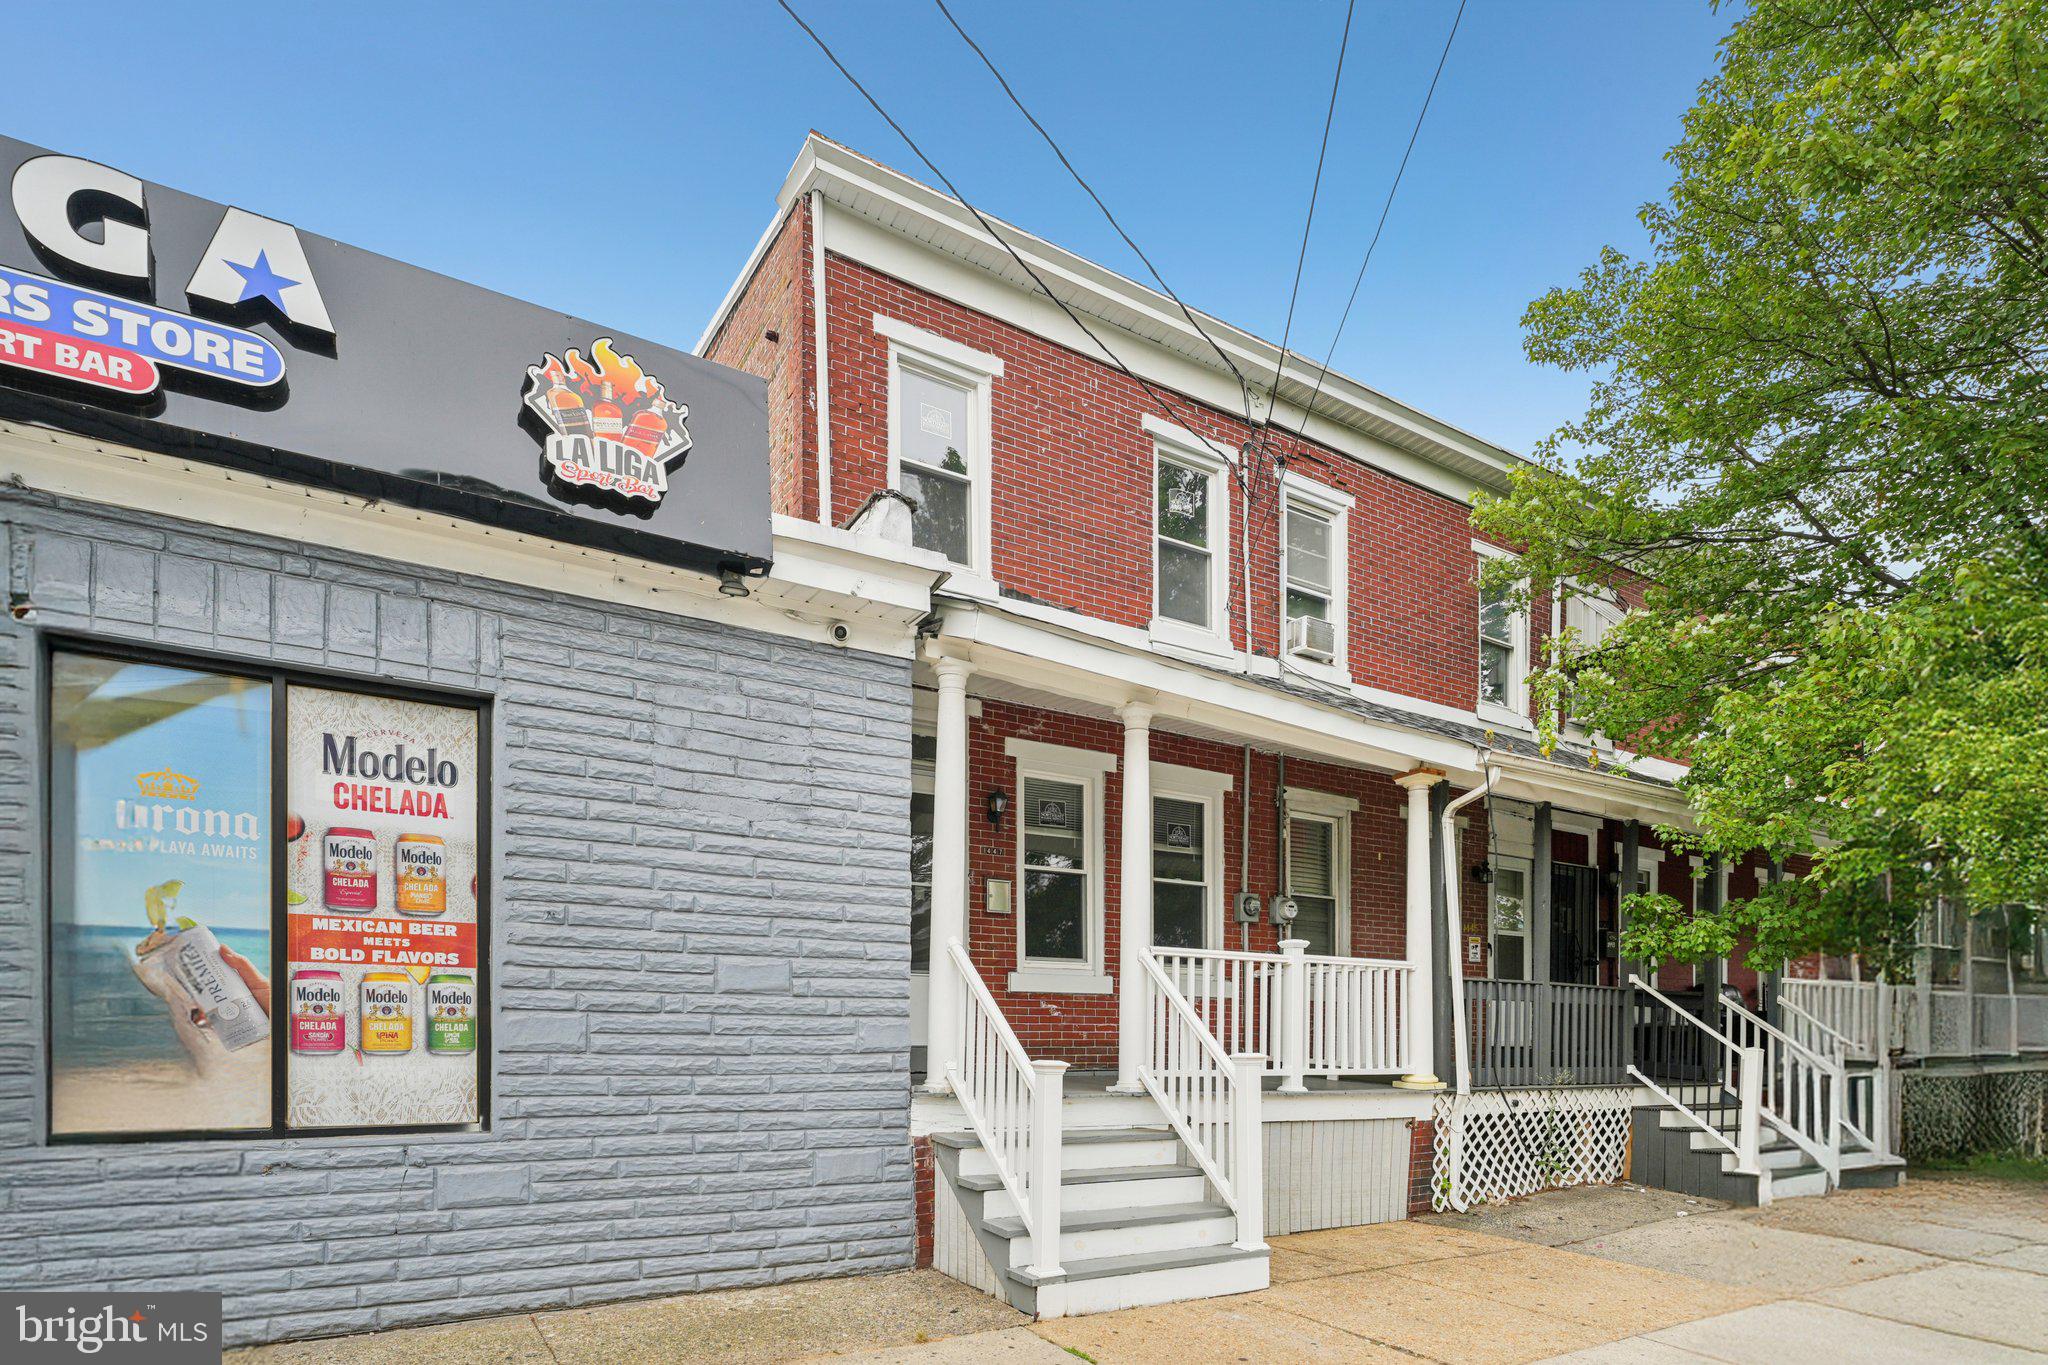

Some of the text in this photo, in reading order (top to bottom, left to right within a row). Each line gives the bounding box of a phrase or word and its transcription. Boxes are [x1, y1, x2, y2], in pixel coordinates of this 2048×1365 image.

[73, 300, 264, 377] STORE
[0, 328, 132, 382] RT BAR
[556, 438, 659, 485] LA LIGA
[561, 460, 656, 498] Sport Bar
[366, 729, 416, 744] CERVEZA
[322, 732, 459, 788] Modelo
[333, 782, 448, 819] CHELADA
[201, 844, 257, 860] AWAITS
[329, 843, 372, 860] Modelo
[401, 848, 442, 865] Modelo
[332, 877, 369, 888] CHELADA
[404, 882, 439, 892] CHELADA
[312, 917, 457, 937] MEXICAN BEER
[363, 936, 411, 947] MEETS
[310, 947, 459, 965] BOLD FLAVORS
[296, 986, 340, 1002] Modelo
[365, 988, 407, 1003] Modelo
[432, 990, 472, 1005] Modelo
[299, 1021, 337, 1030] CHELADA
[369, 1022, 405, 1031] CHELADA
[434, 1023, 469, 1032] CHELADA
